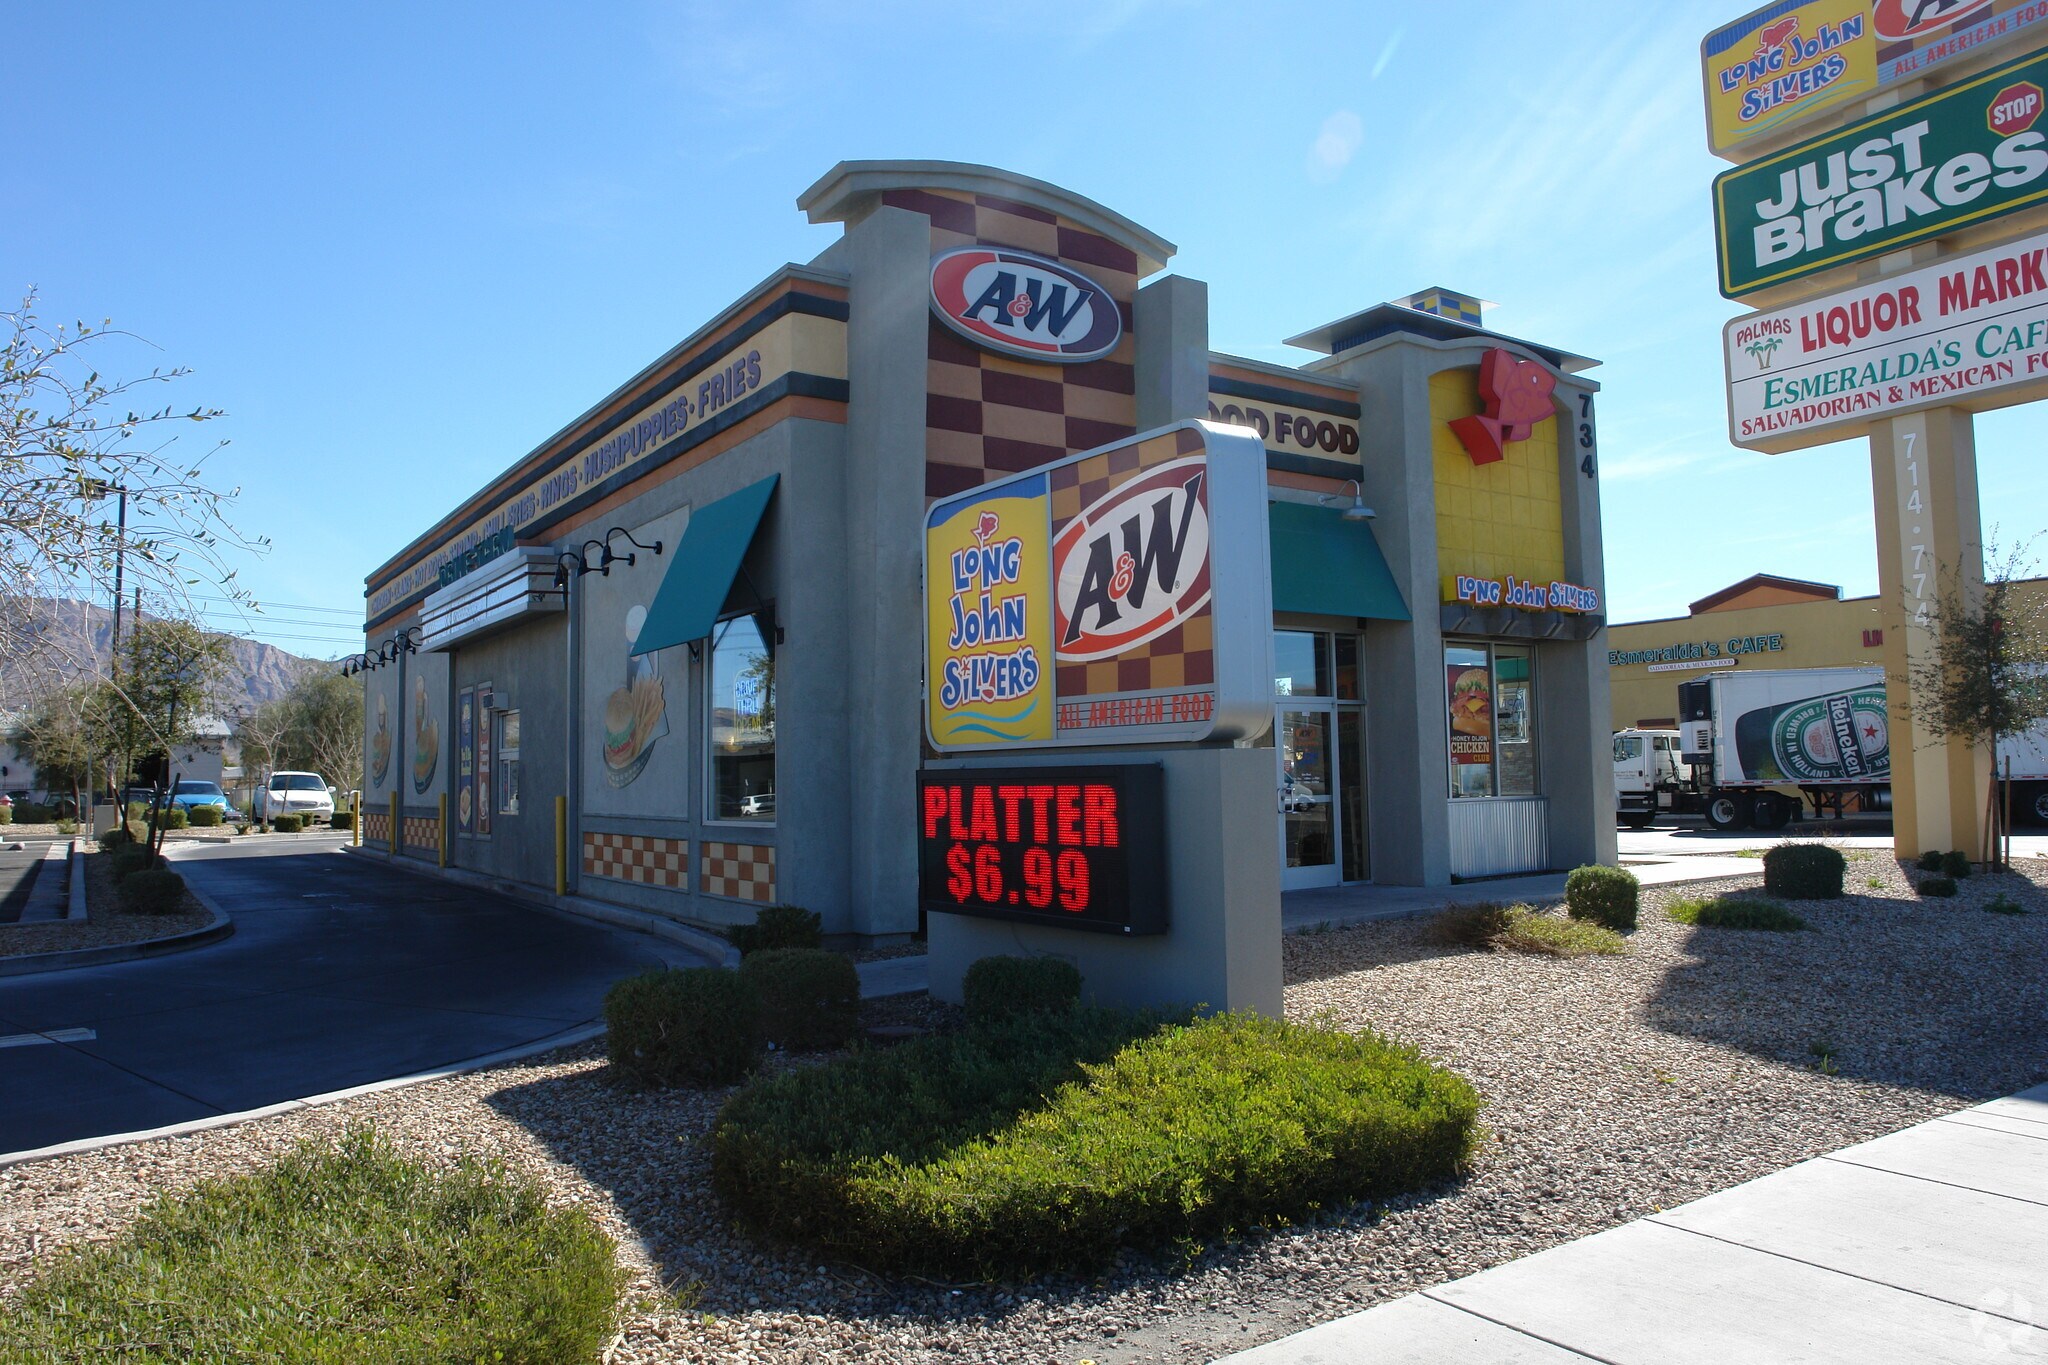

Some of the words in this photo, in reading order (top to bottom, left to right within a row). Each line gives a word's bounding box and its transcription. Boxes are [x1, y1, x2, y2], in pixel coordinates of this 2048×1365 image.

[1719, 48, 1784, 92] LONG
[1895, 56, 1918, 77] ALL
[1927, 18, 2007, 64] AMERICAN
[1993, 94, 2037, 125] STOP
[1755, 120, 1929, 220] JUST
[1753, 131, 2048, 269] Brakes
[960, 271, 1094, 338] A&W
[1800, 285, 1922, 353] LIQUOR
[1939, 248, 2048, 317] MARK
[1737, 318, 1792, 347] PALMAS
[1763, 340, 1961, 410] ESMERALDA'S
[1975, 319, 2048, 358] CAF
[1741, 386, 1881, 436] SALVADORIAN
[1888, 386, 1904, 404] &
[1909, 359, 2014, 399] MEXICAN
[540, 465, 578, 511] RINGS
[583, 395, 688, 486] HUSHPUPPIES
[698, 350, 762, 420] FRIES
[1274, 411, 1359, 455] FOOD
[1579, 393, 1595, 479] 734
[951, 538, 1022, 592] LONG
[1061, 470, 1204, 648] A&W
[1456, 575, 1501, 603] LONG
[1608, 641, 1720, 666] Esmeralda's
[1727, 633, 1784, 656] CAFE
[737, 698, 759, 715] THRU
[1060, 704, 1082, 727] ALL
[1088, 699, 1163, 725] AMERICAN
[1172, 694, 1212, 722] FOOD
[1786, 707, 1815, 739] BREWED
[1451, 741, 1490, 753] CHICKEN
[1473, 754, 1490, 762] CLUB
[1786, 742, 1798, 753] IN
[1830, 698, 1860, 775] Heineken
[1790, 754, 1830, 778] HOLLAND
[924, 784, 1120, 848] PLATTER
[946, 841, 1090, 912] $6.99
